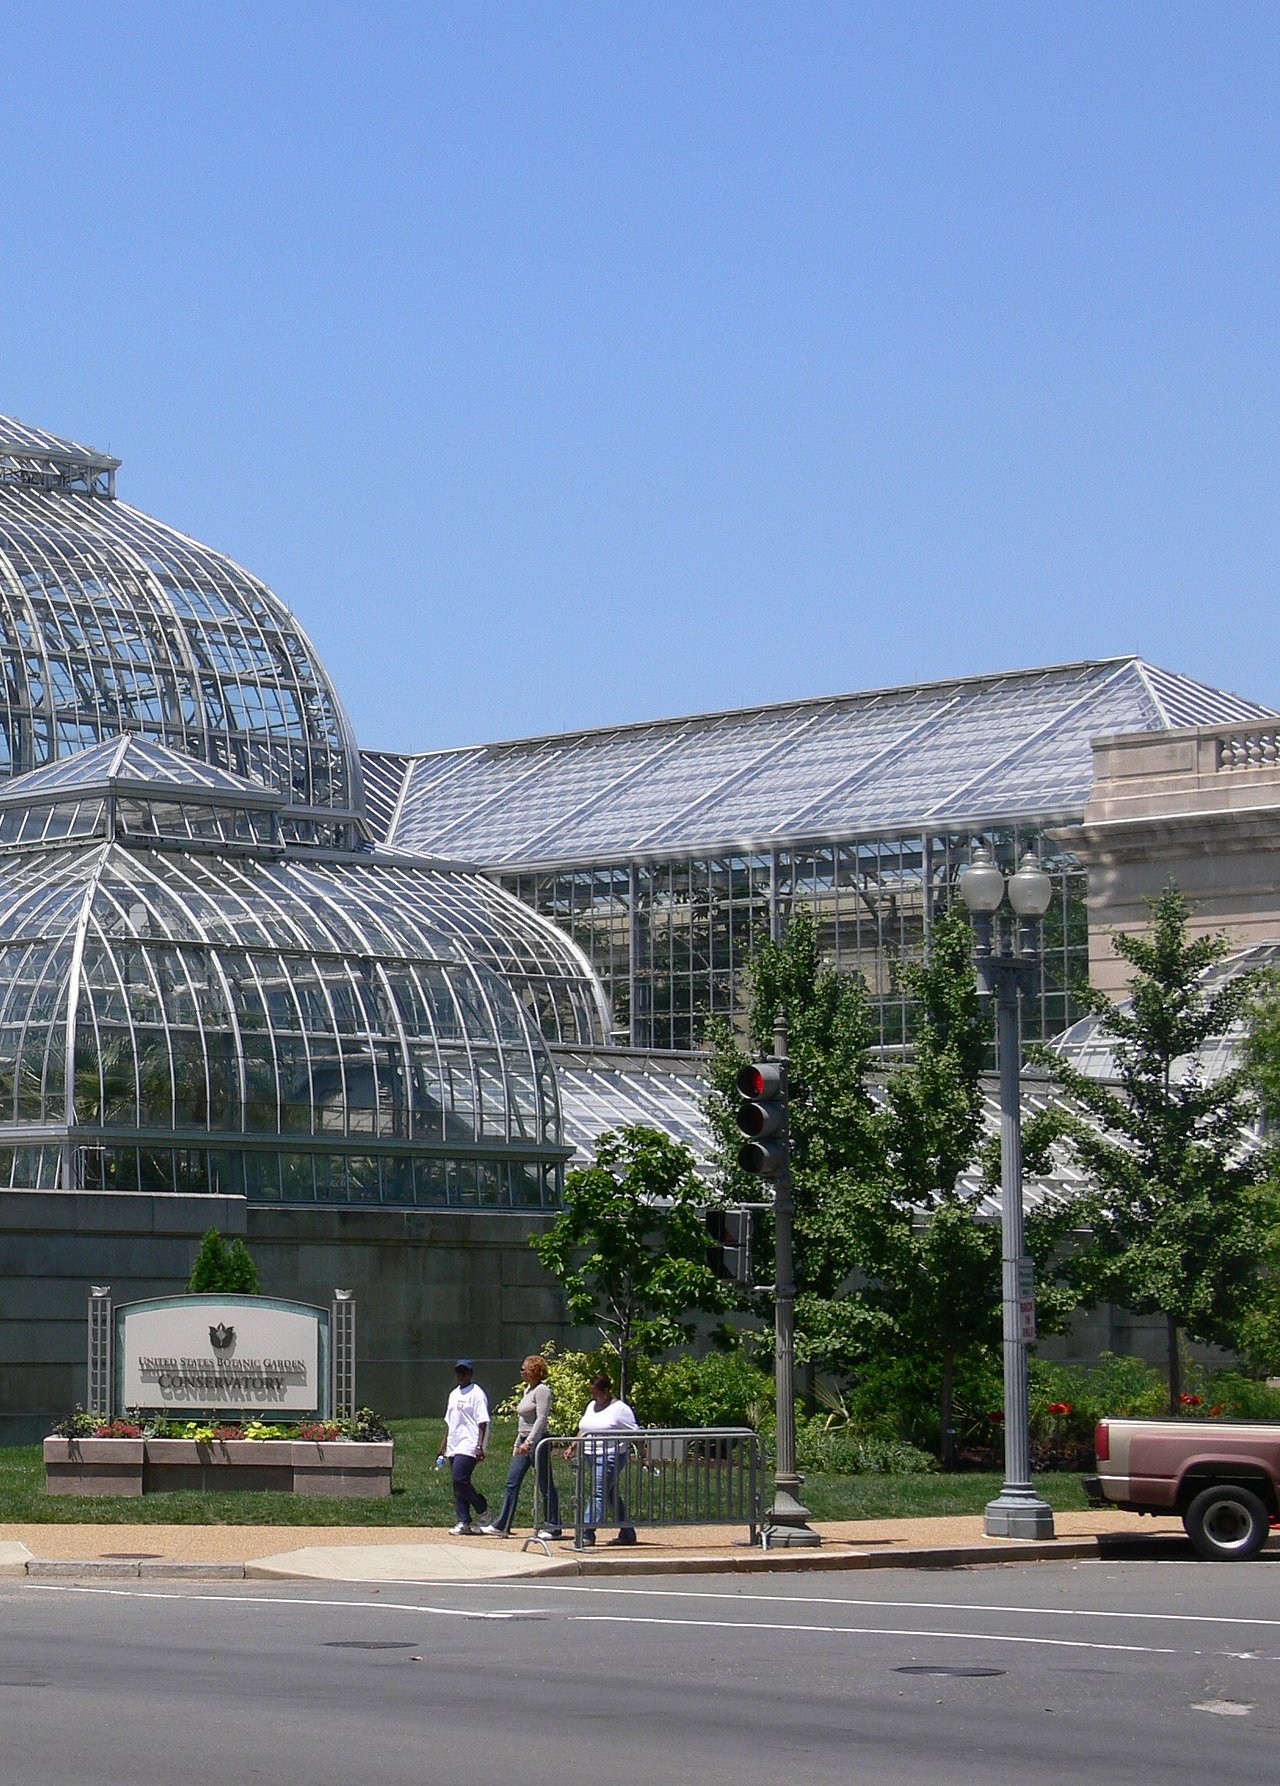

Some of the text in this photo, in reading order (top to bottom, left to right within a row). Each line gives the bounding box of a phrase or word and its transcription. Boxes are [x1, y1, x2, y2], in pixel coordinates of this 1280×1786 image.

[138, 1356, 306, 1370] UNITED STATES BOTANIC GARDEN
[158, 1375, 287, 1390] CONSERVATORY
